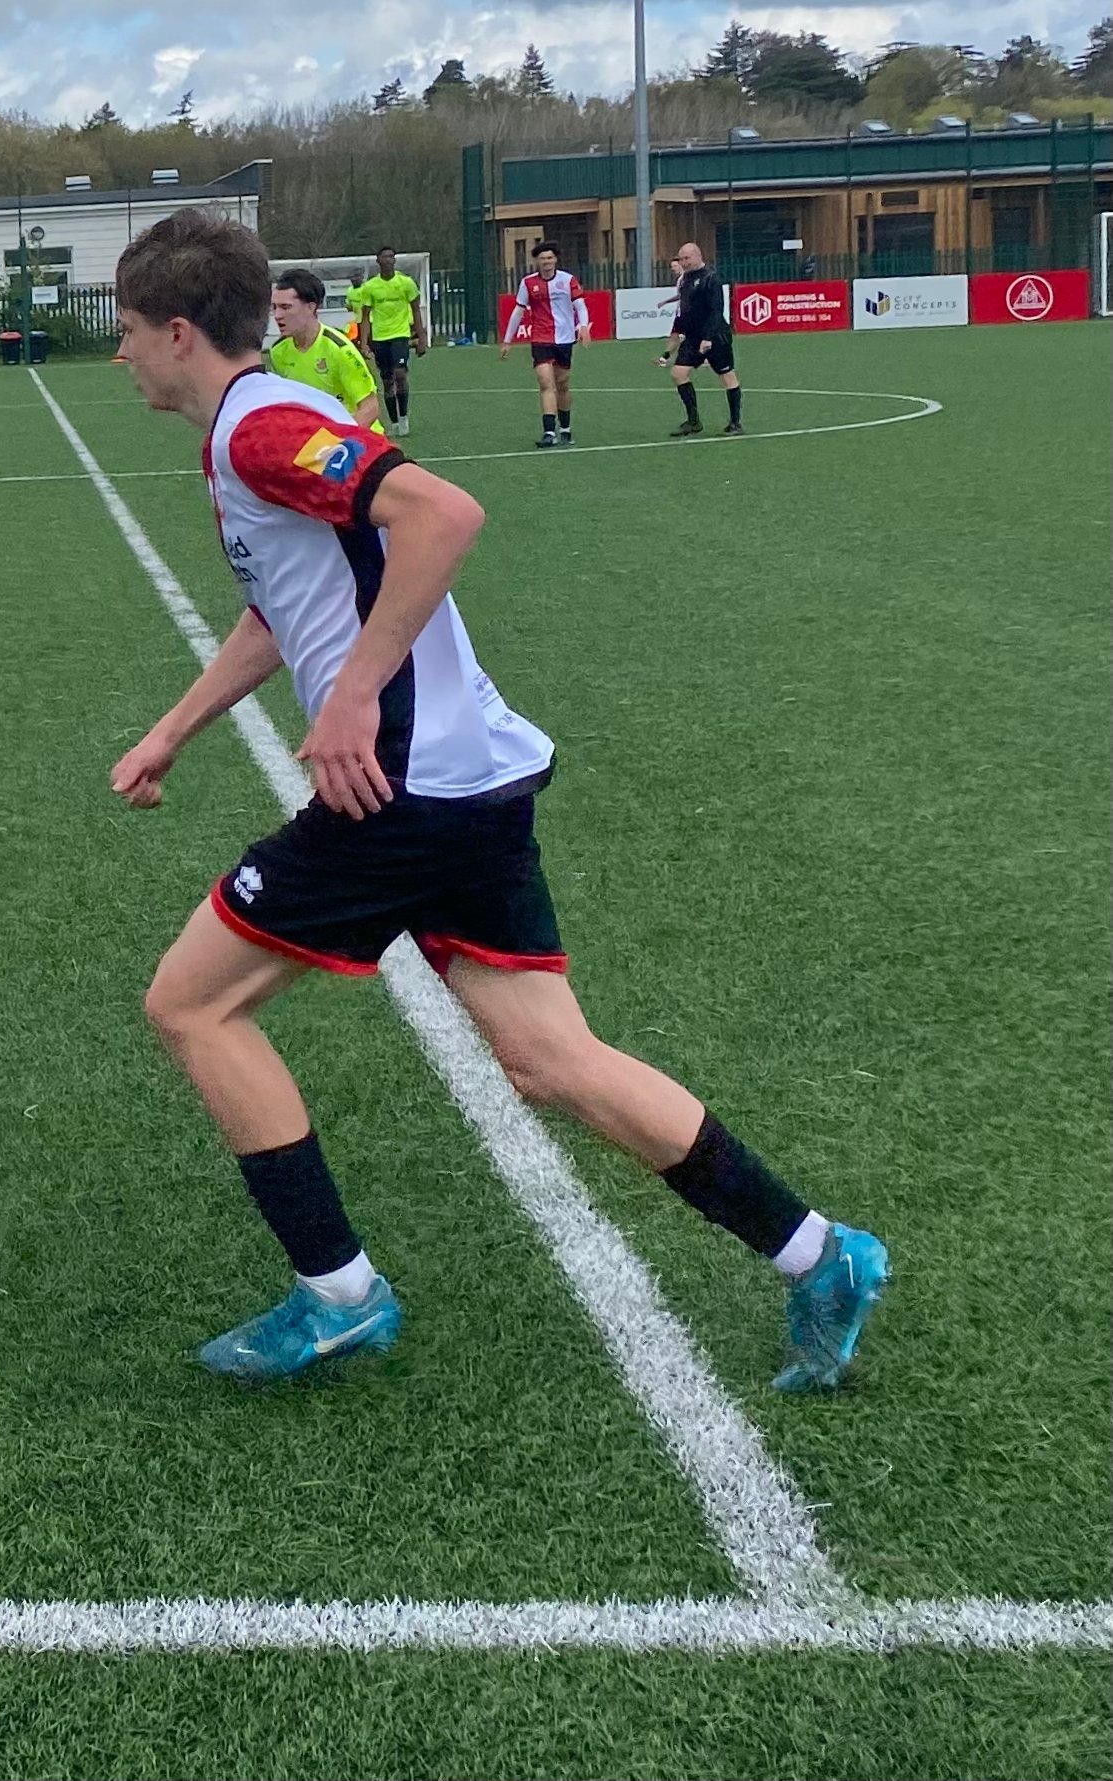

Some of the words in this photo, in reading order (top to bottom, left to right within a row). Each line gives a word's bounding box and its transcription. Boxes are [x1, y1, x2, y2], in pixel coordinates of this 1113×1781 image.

[894, 295, 922, 303] CITY
[777, 301, 841, 310] CONSTRUCTION
[894, 301, 957, 310] CONCEPTS
[621, 310, 657, 319] Gama
